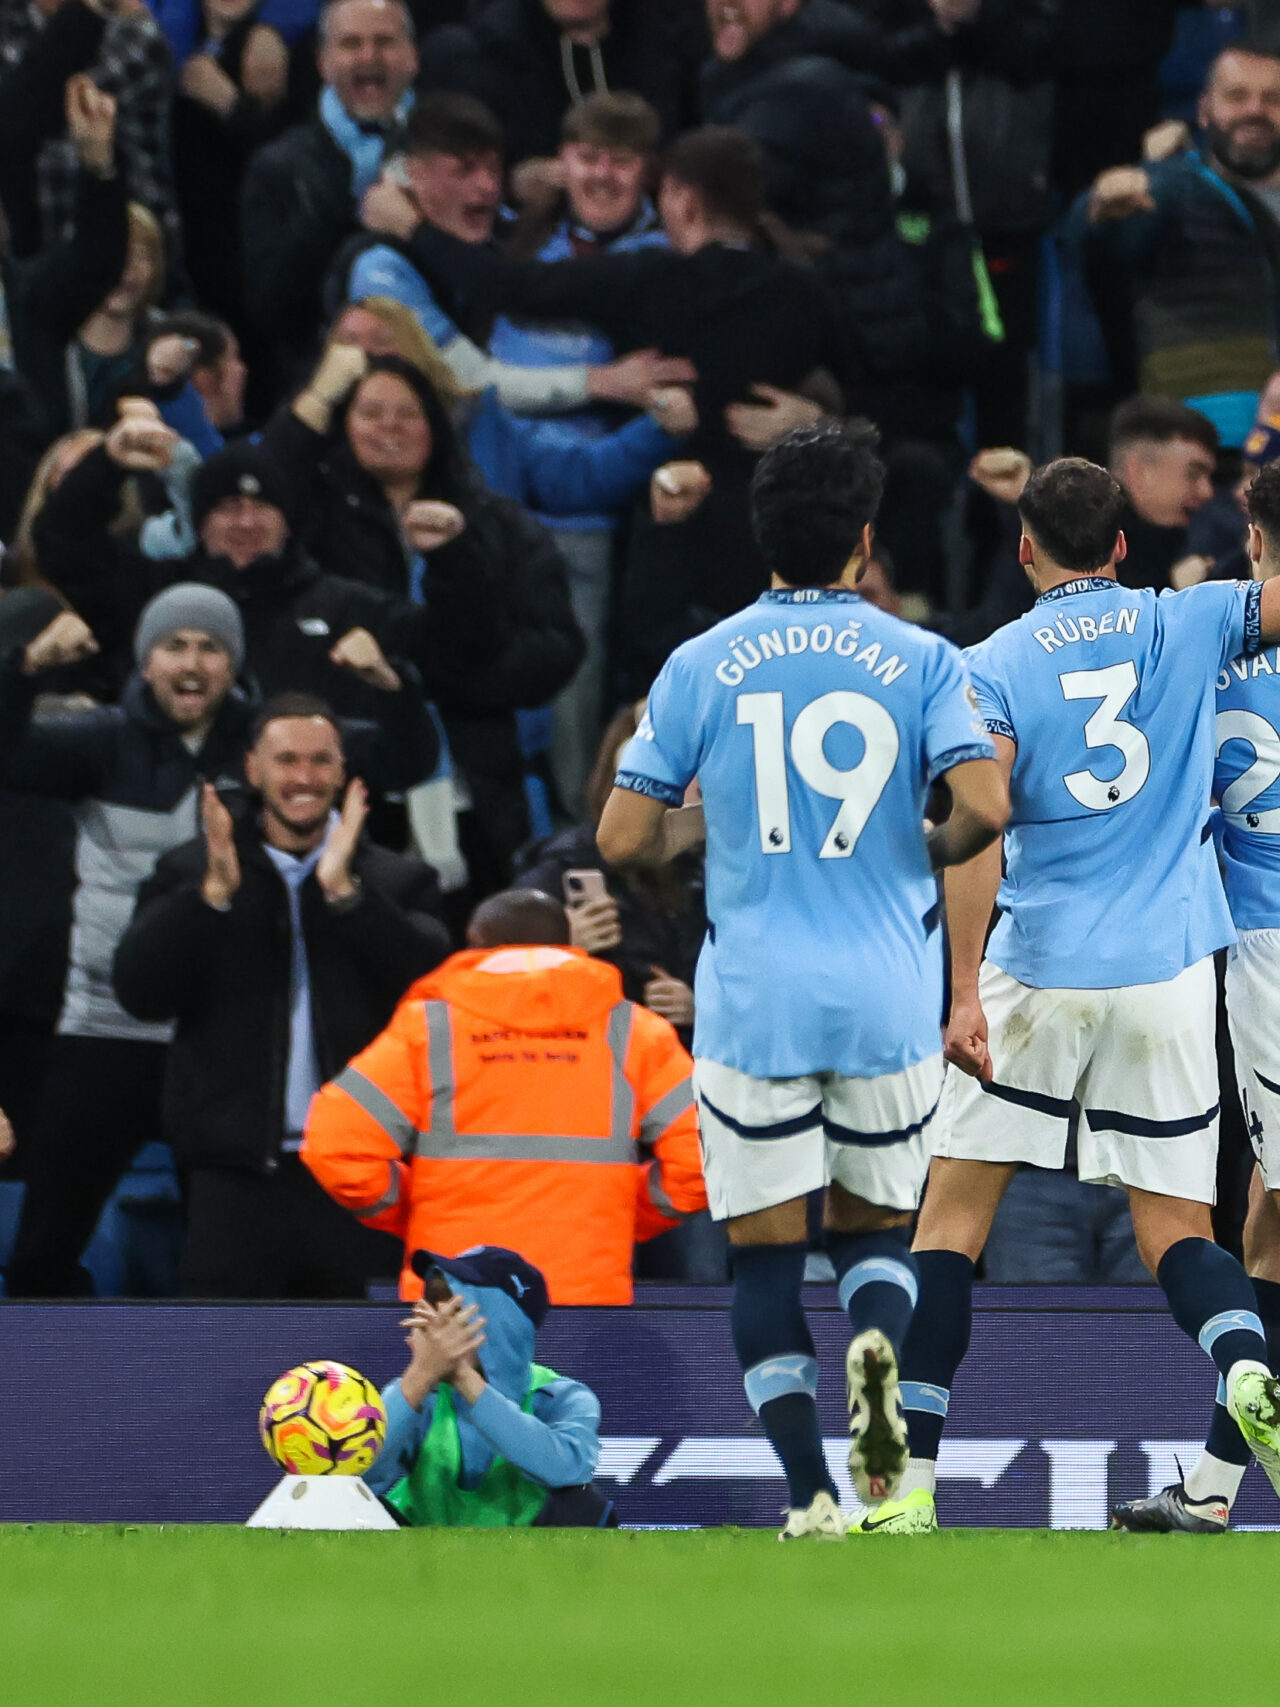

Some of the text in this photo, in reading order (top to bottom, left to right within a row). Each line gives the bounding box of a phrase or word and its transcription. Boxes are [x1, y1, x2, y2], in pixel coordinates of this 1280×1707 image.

[716, 620, 909, 686] GÜNDOĞAN
[1032, 608, 1140, 654] RÚBEN
[736, 691, 900, 859] 19
[1058, 660, 1151, 810] 3
